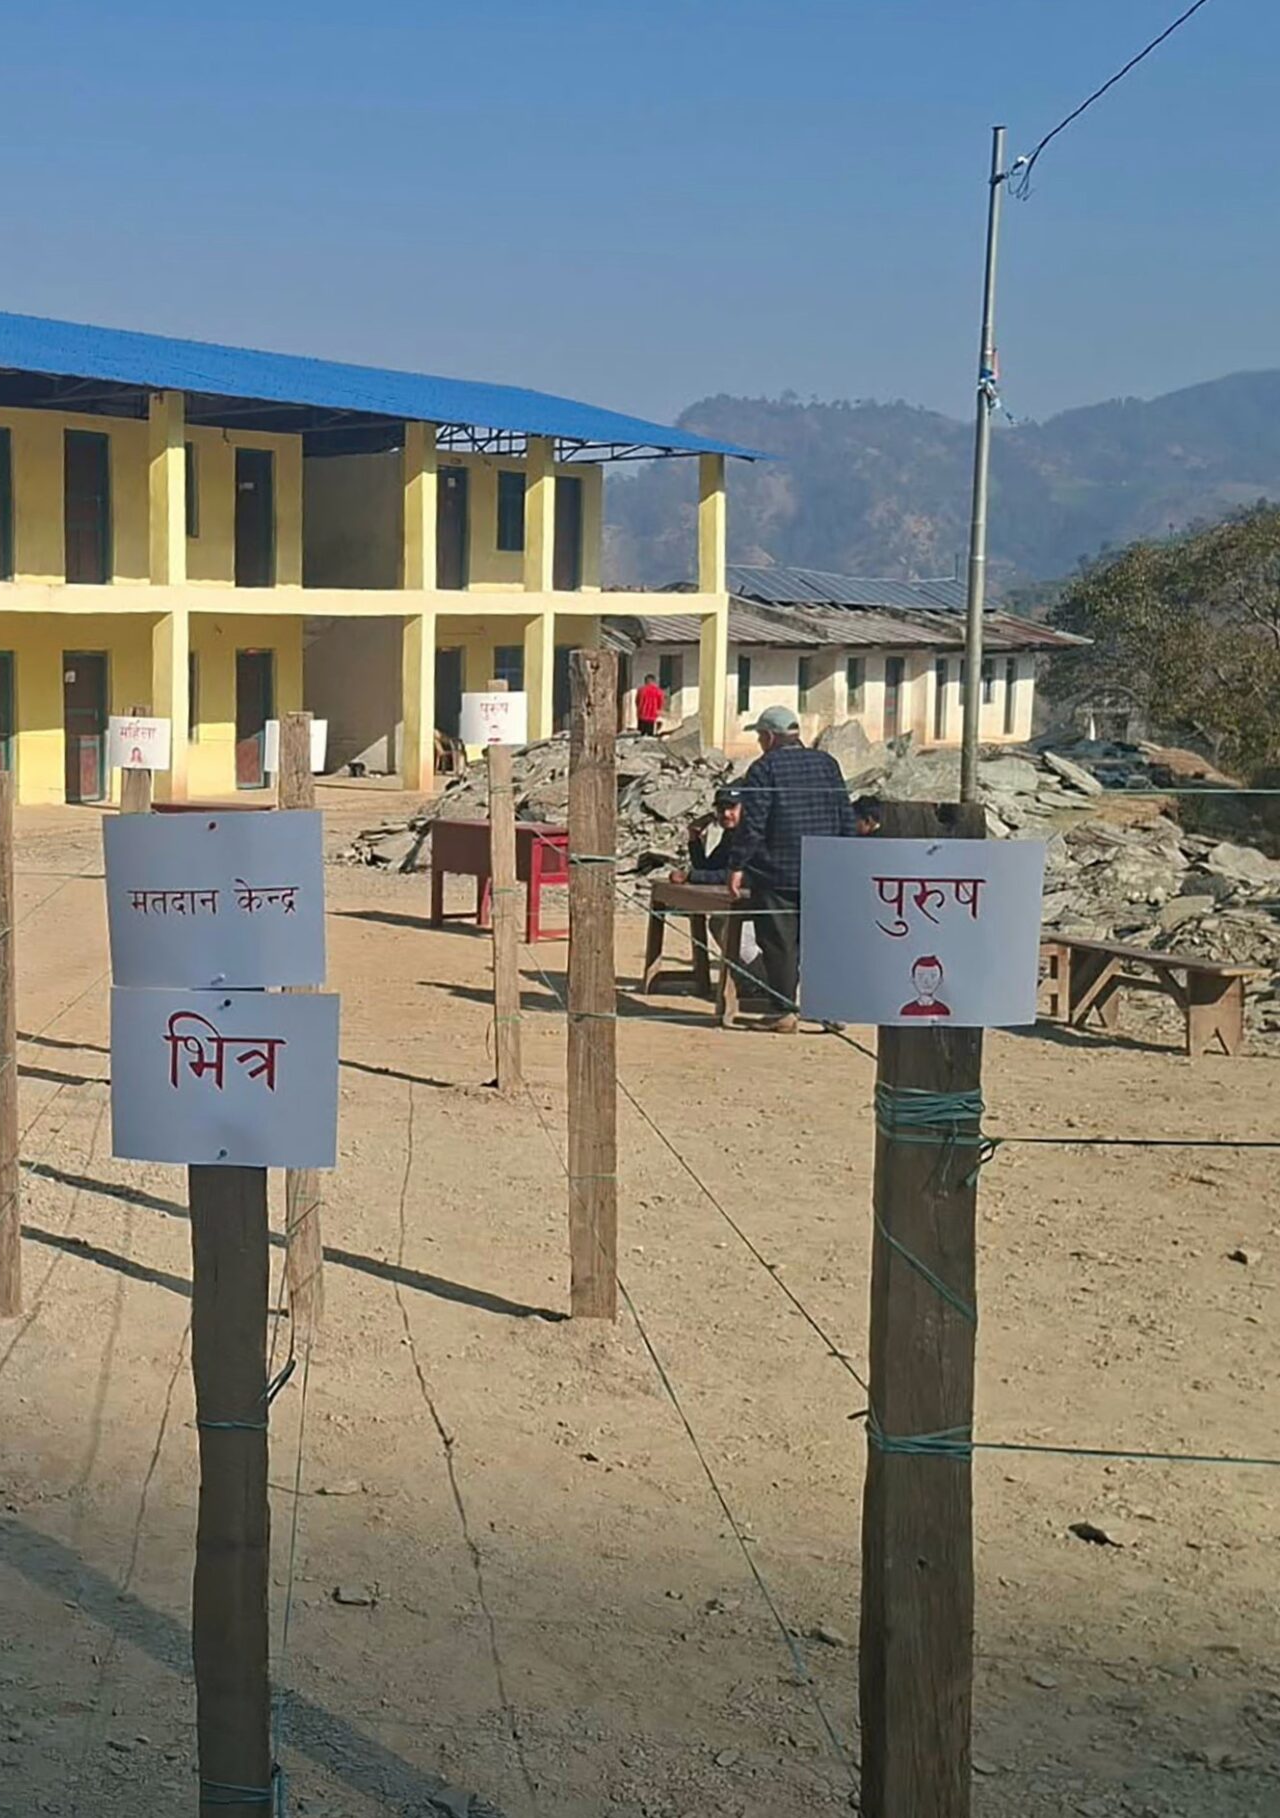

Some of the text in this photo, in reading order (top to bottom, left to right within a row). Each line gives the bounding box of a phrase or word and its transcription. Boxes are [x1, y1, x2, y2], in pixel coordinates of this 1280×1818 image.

[127, 878, 300, 916] मतदान केन्द्र
[872, 876, 987, 937] पुरुष
[162, 1010, 287, 1092] भित्र
